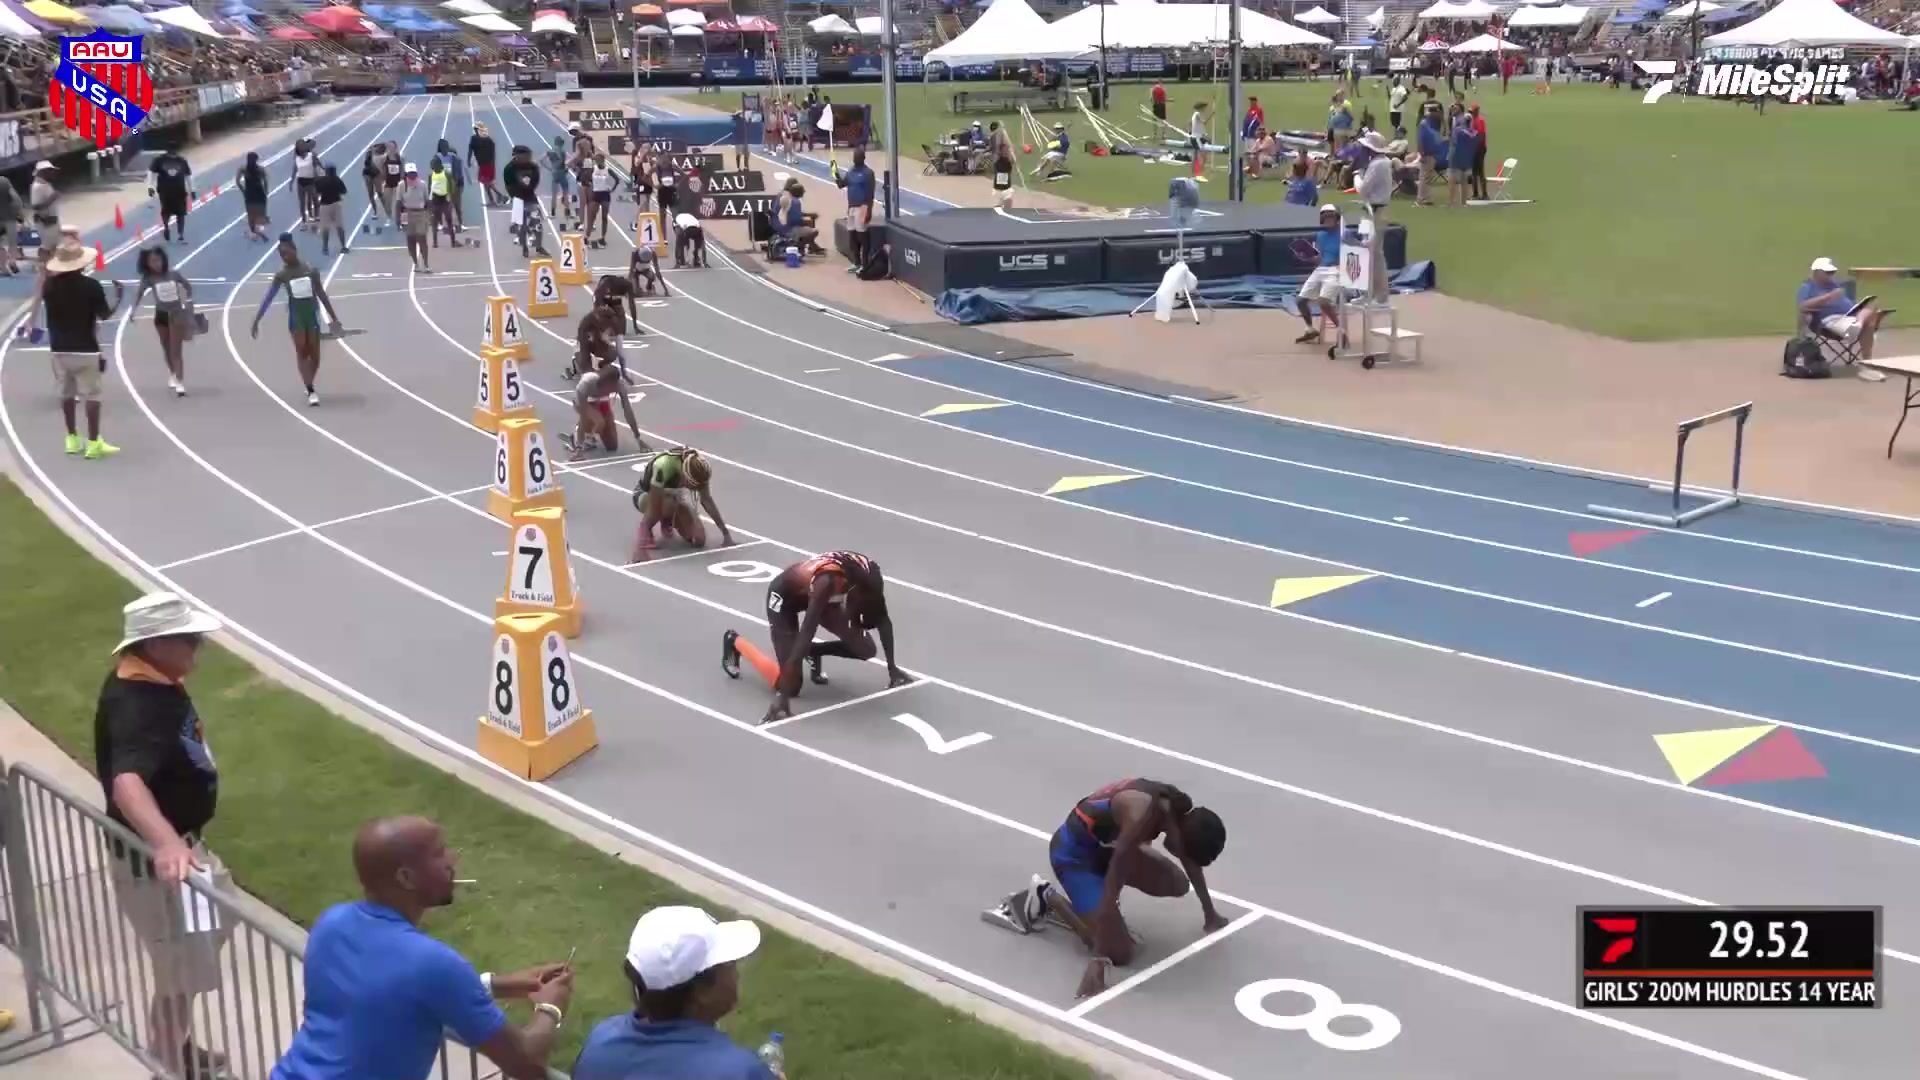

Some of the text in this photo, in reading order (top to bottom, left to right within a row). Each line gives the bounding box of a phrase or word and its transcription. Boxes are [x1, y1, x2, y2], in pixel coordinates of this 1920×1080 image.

[604, 119, 627, 129] AAU
[708, 175, 746, 191] AAU
[644, 224, 653, 241] 1
[563, 248, 573, 267] 2
[999, 254, 1048, 268] UCS
[1158, 246, 1206, 261] UCS
[540, 275, 553, 297] 3
[485, 314, 491, 337] 4
[505, 313, 517, 337] 4
[480, 371, 488, 402] 5
[506, 371, 520, 402] 5
[498, 448, 506, 484] 6
[529, 447, 545, 483] 6
[518, 546, 544, 589] 7
[495, 660, 513, 716] 8
[548, 657, 570, 712] 8
[890, 713, 996, 755] 7
[1234, 978, 1402, 1051] 8
